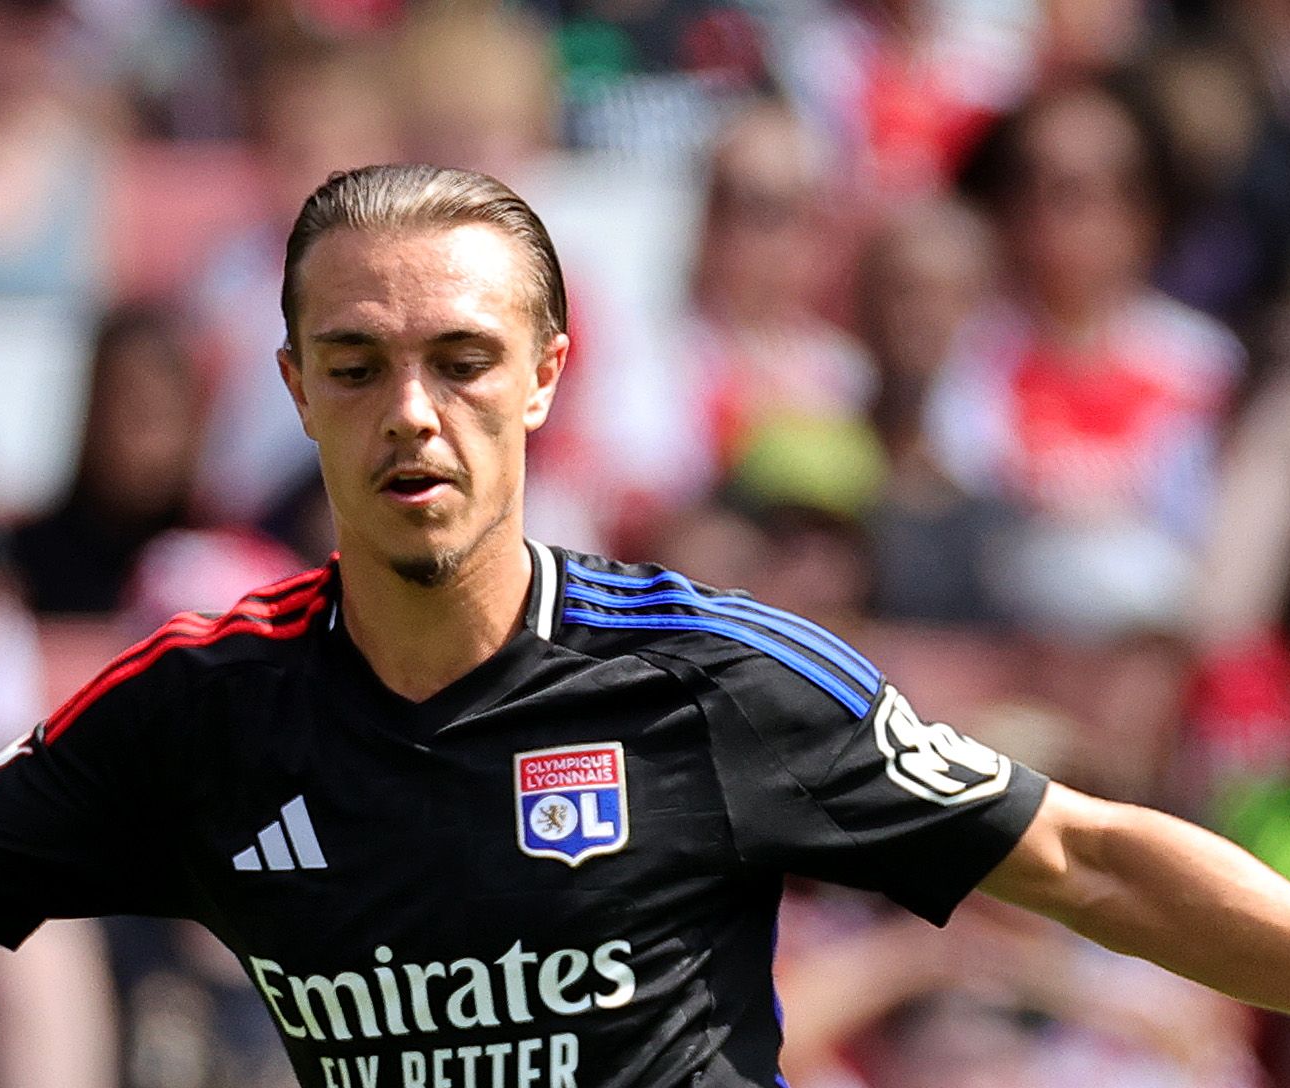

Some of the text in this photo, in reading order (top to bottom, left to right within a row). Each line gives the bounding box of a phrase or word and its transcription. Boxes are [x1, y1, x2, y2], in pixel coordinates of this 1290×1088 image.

[525, 754, 613, 774] OLYMPIQUE
[526, 768, 614, 789] LYONNAIS
[248, 938, 637, 1042] Emirates
